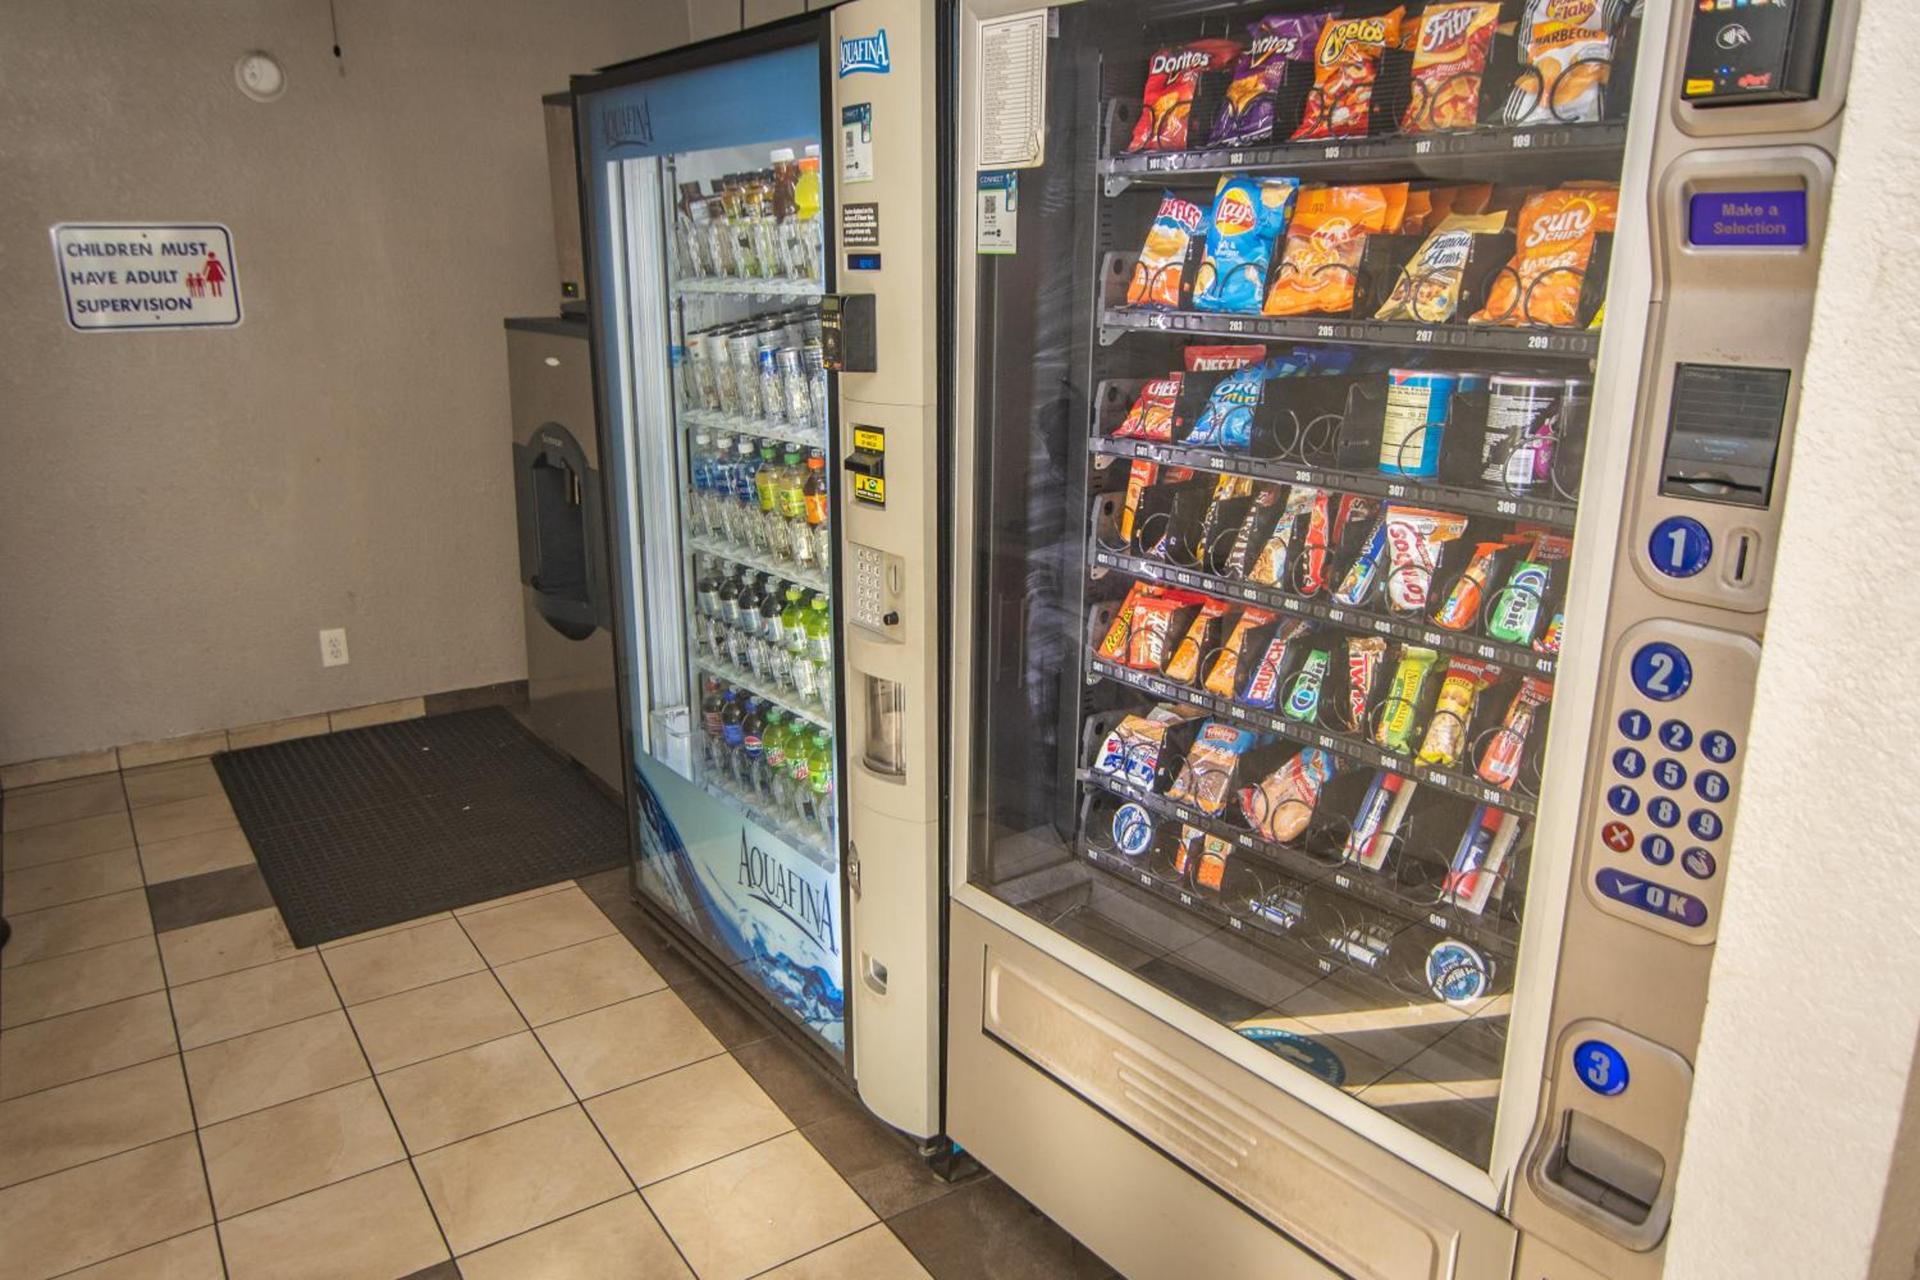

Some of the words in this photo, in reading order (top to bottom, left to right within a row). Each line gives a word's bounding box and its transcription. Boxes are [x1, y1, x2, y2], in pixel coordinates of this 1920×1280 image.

[1152, 51, 1210, 74] Doritos
[1416, 141, 1431, 153] 107
[1512, 134, 1530, 148] 109
[1325, 147, 1339, 158] 105
[1722, 203, 1764, 217] Make
[1769, 206, 1779, 217] a
[1713, 221, 1787, 236] Selection
[67, 243, 153, 257] CHILDREN
[161, 242, 208, 256] MUST
[71, 271, 118, 285] HAVE
[125, 270, 179, 284] ADULT
[77, 298, 193, 313] SUPERVISION
[1229, 320, 1243, 331] 203
[1318, 325, 1333, 337] 205
[1416, 330, 1433, 342] 207
[1528, 336, 1548, 349] 209
[1296, 470, 1311, 482] 305
[1388, 484, 1404, 497] 307
[1497, 500, 1516, 514] 309
[1668, 528, 1687, 568] 1
[1329, 609, 1344, 622] 407
[1374, 620, 1391, 633] 408
[1424, 632, 1441, 646] 409
[1478, 644, 1494, 658] 410
[1249, 640, 1287, 700] CRUNCH
[1536, 659, 1552, 672] 411
[1647, 652, 1674, 693] 2
[1319, 735, 1334, 748] 507
[1630, 714, 1641, 736] 1
[1670, 724, 1684, 747] 2
[1712, 735, 1728, 758] 3
[1380, 756, 1397, 770] 508
[1430, 772, 1447, 786] 509
[1622, 752, 1637, 773] 4
[1664, 762, 1678, 782] 5
[1706, 775, 1721, 796] 6
[1484, 789, 1500, 803] 510
[1620, 789, 1632, 810] 7
[1658, 801, 1673, 823] 8
[1698, 813, 1714, 835] 9
[1652, 838, 1666, 859] 0
[737, 825, 838, 956] AQUAFINA
[1646, 887, 1688, 918] OK
[1588, 1051, 1610, 1085] 3
